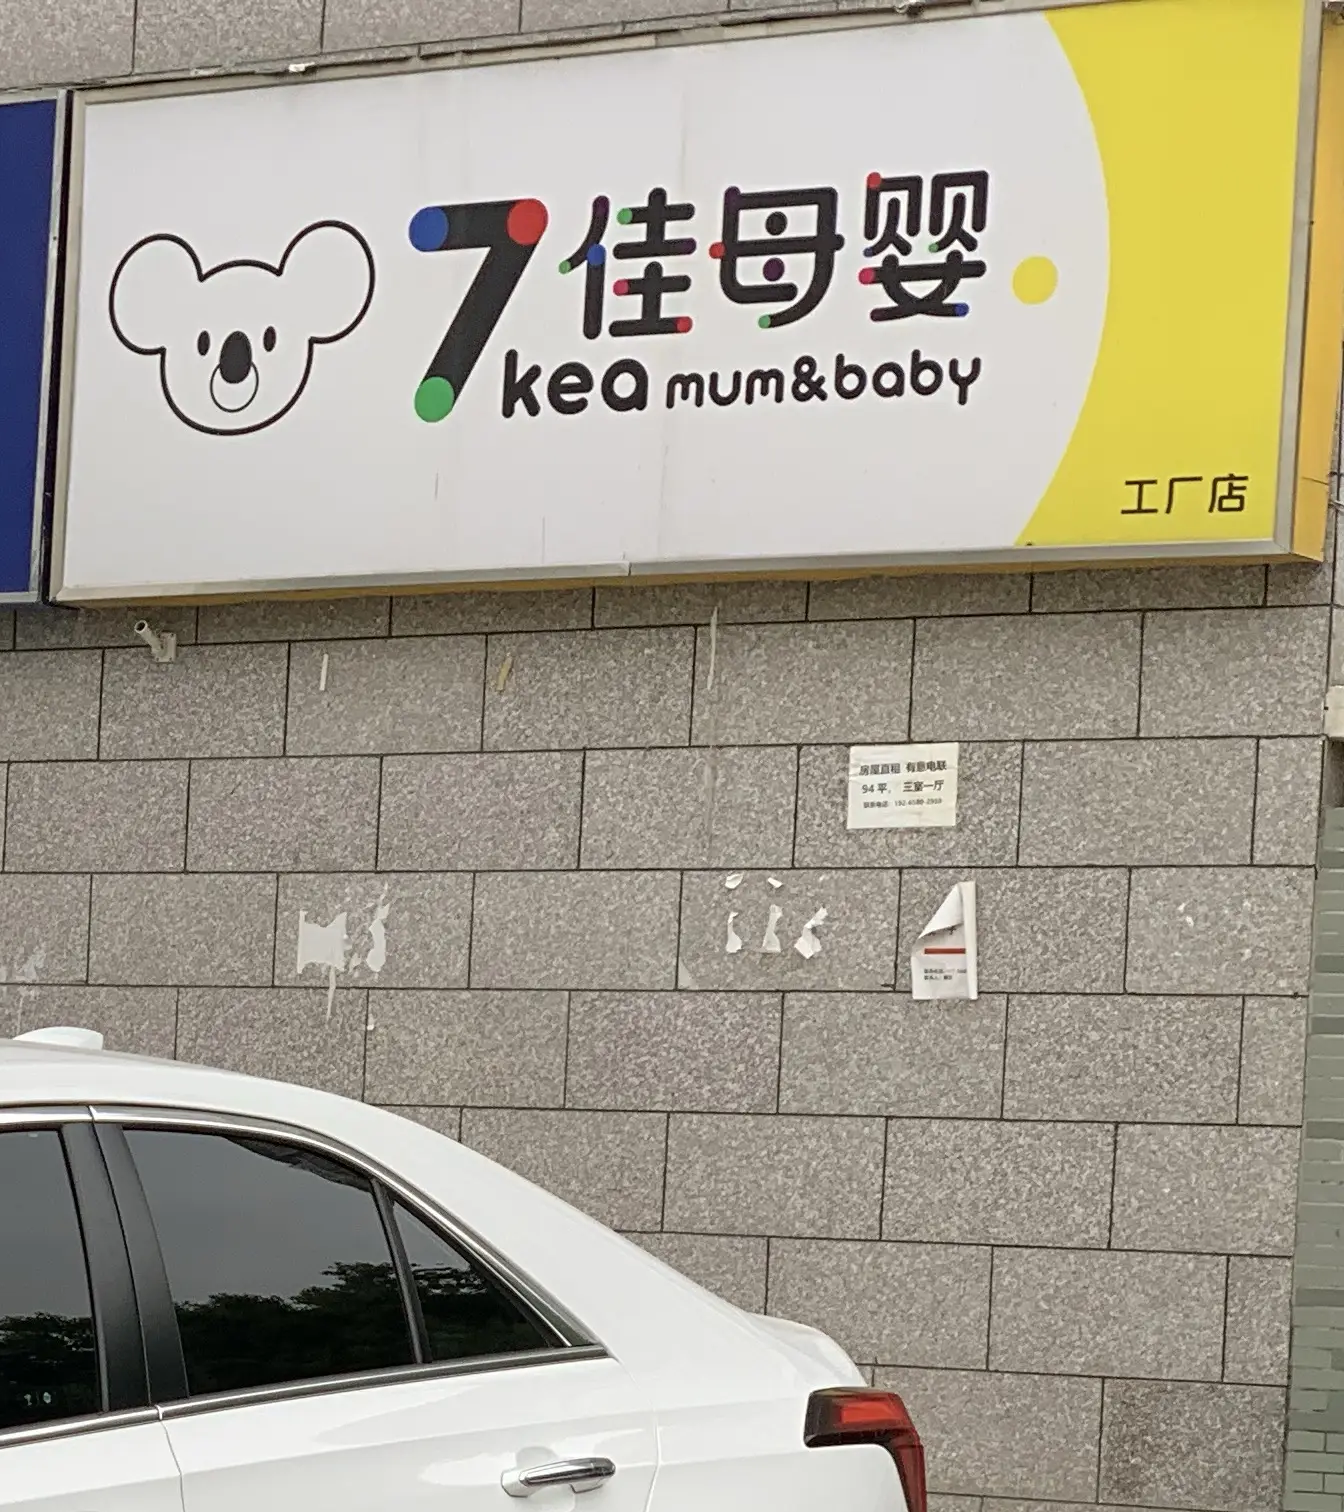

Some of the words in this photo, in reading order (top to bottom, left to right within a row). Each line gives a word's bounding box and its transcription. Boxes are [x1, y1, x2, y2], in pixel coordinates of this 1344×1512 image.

[666, 346, 983, 412] mum&baby
[1120, 473, 1249, 516] 工厂店
